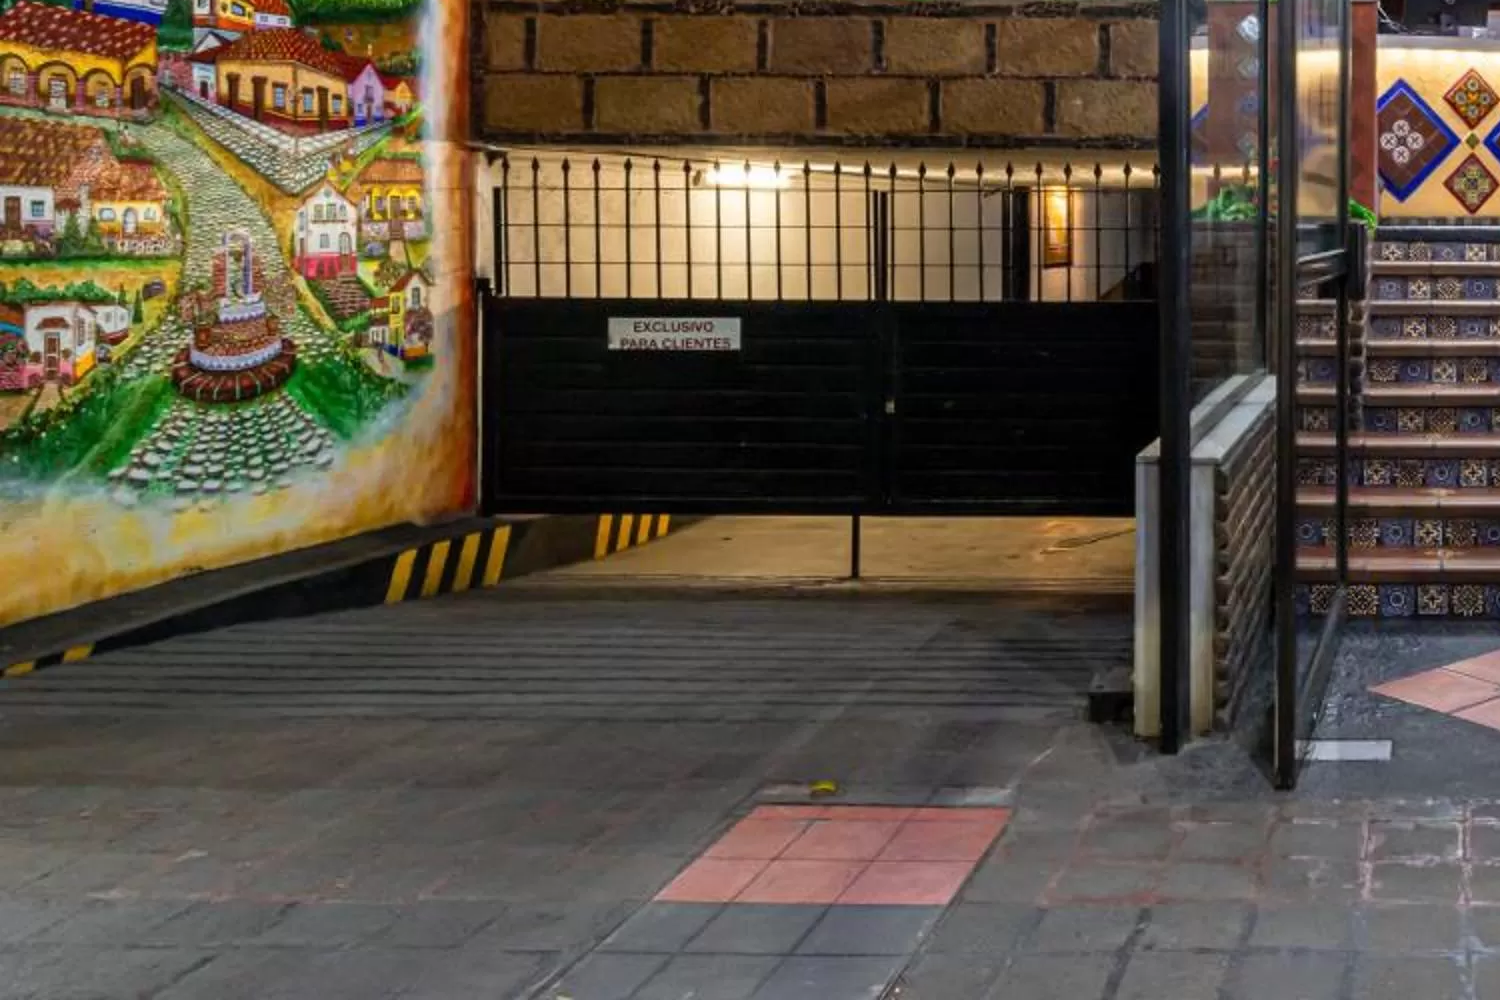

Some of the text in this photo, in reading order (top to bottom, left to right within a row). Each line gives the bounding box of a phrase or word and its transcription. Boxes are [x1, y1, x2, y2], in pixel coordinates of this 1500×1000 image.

[633, 320, 715, 333] EXCLUSIVO
[620, 337, 731, 350] PARA CLIENTES
